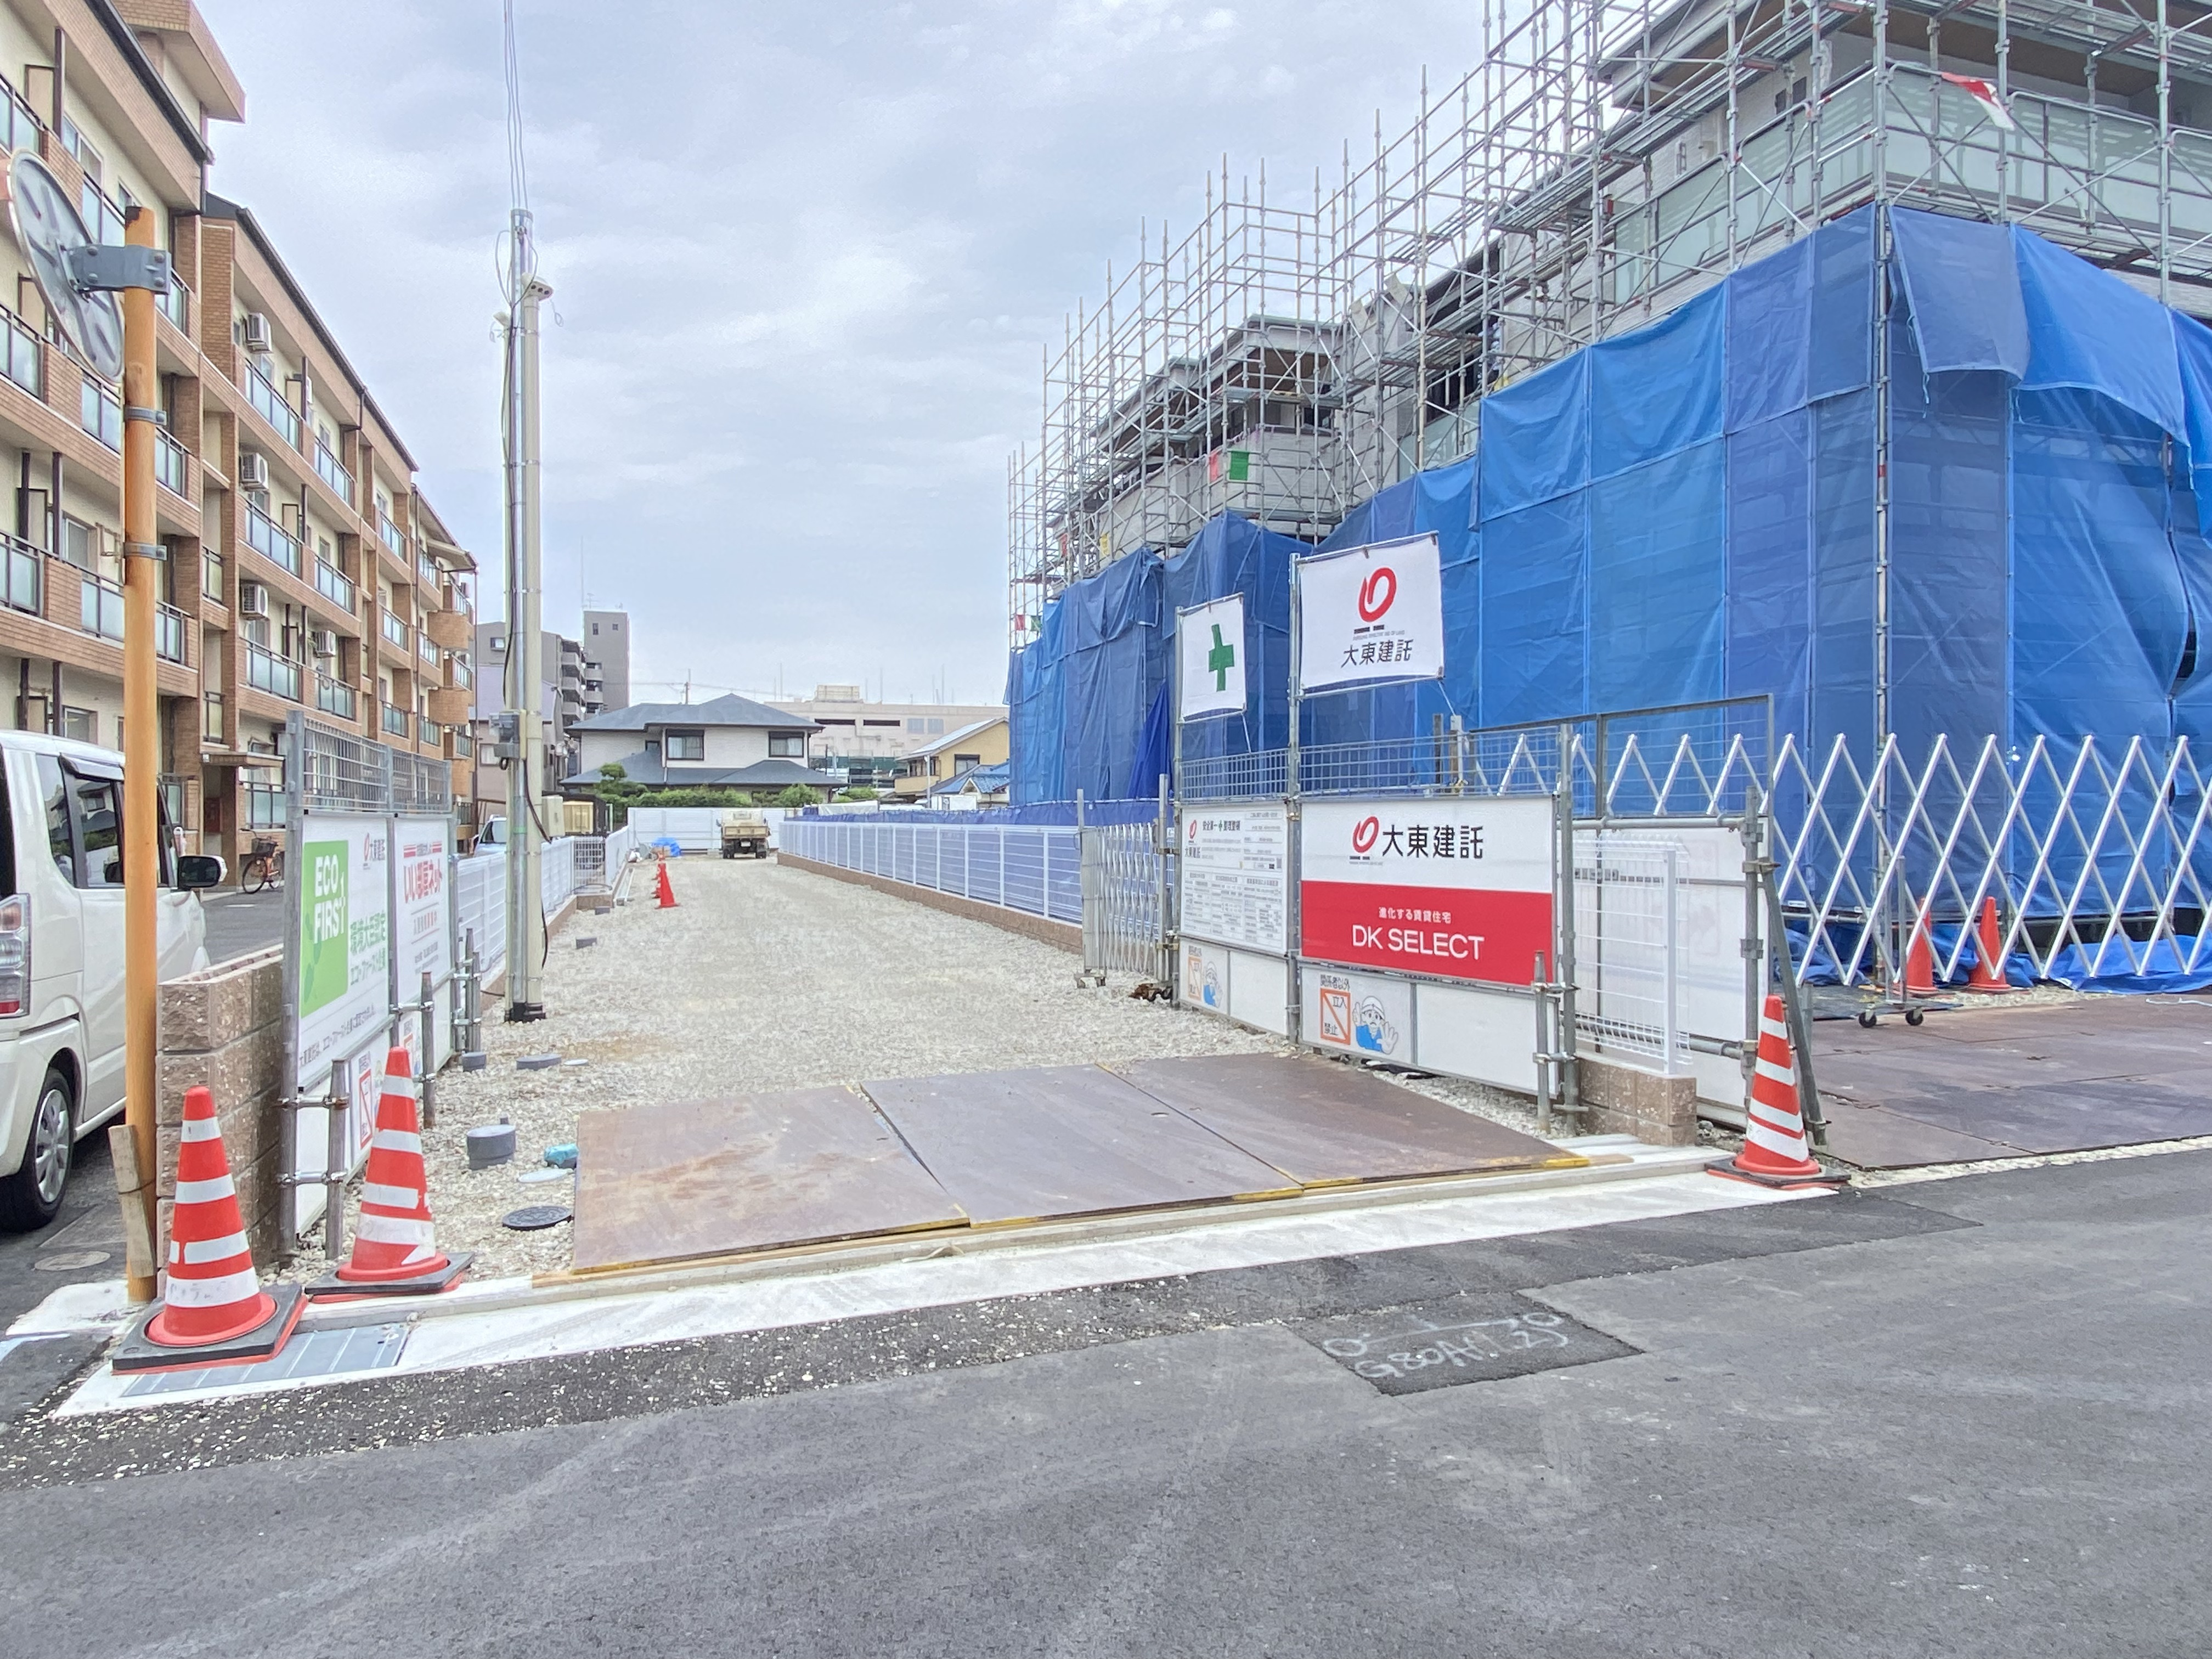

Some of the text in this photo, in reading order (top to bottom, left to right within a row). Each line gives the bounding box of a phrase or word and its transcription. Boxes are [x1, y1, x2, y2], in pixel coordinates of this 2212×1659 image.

[1341, 639, 1414, 668] 大東建託
[1383, 825, 1483, 859] 大東建託
[315, 854, 339, 898] ECO
[1379, 907, 1452, 924] 進化する賃貸住宅
[1352, 924, 1485, 960] DK SELECT
[1332, 996, 1348, 1009] 立入
[1324, 1022, 1339, 1036] 禁止
